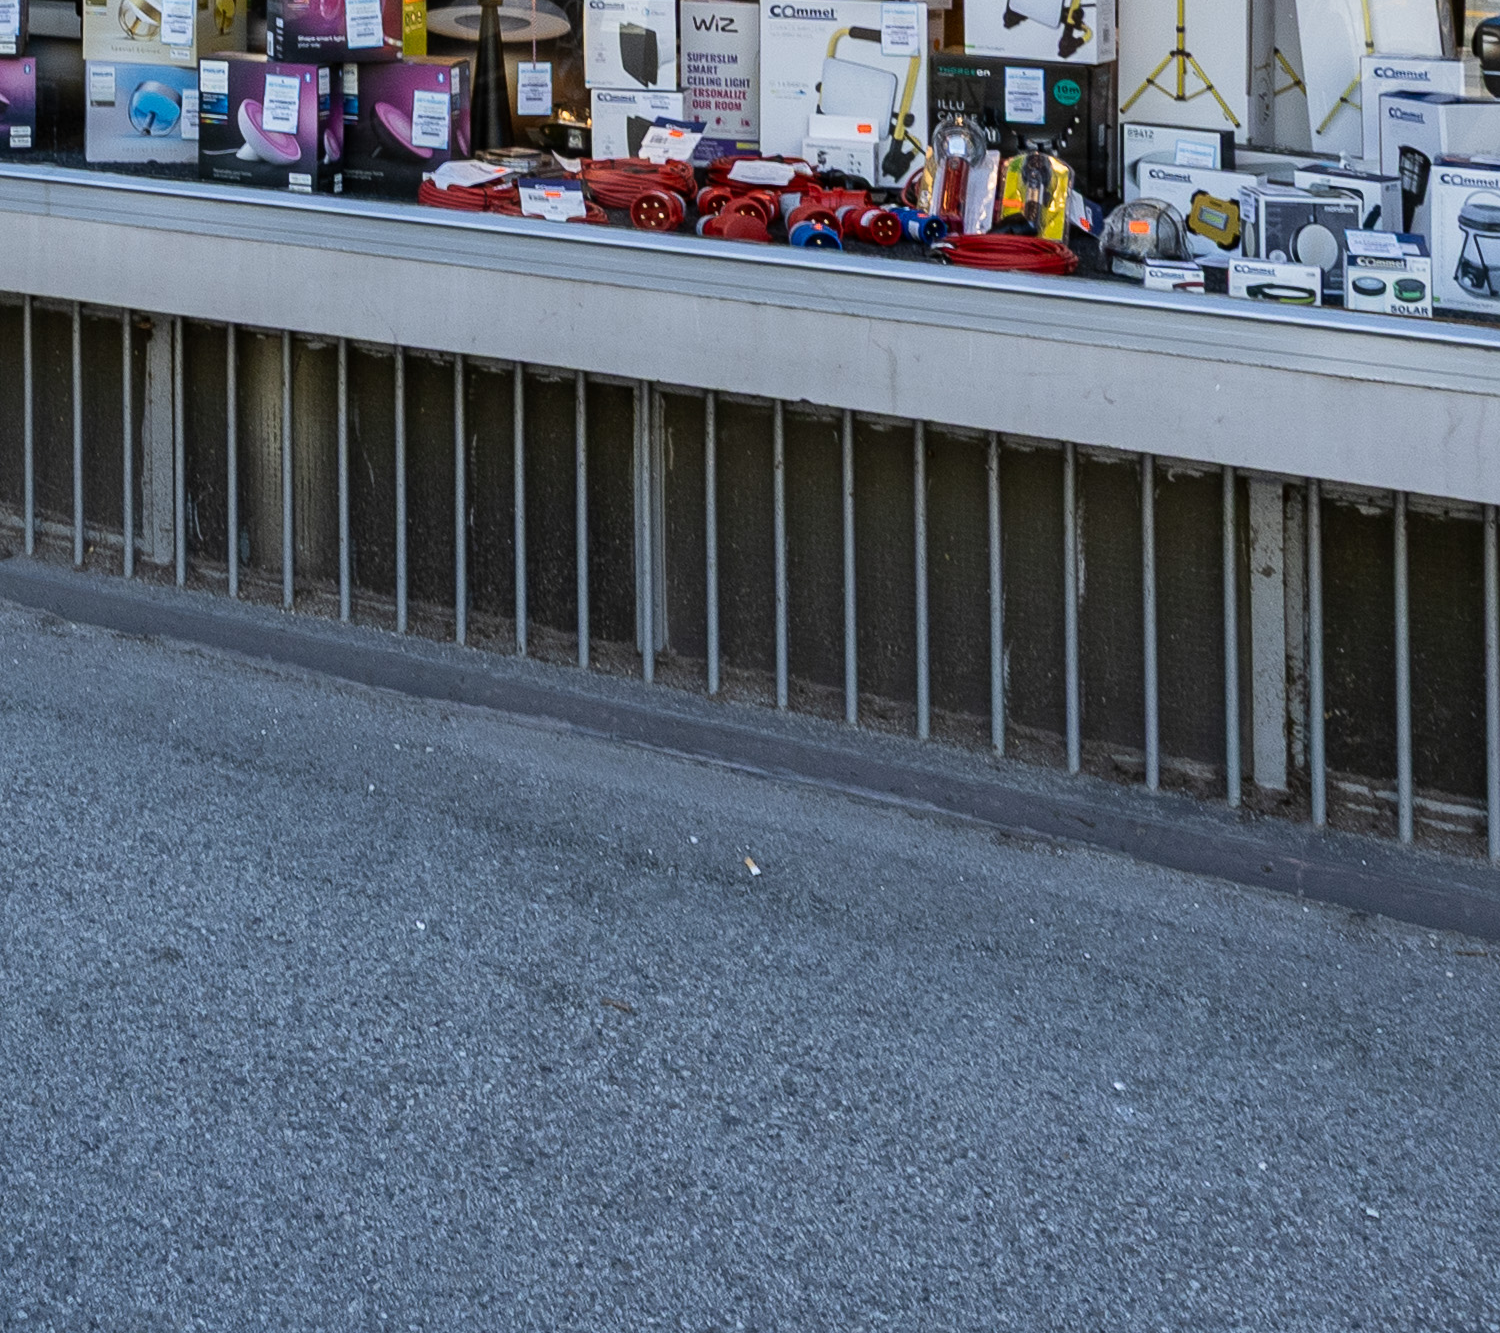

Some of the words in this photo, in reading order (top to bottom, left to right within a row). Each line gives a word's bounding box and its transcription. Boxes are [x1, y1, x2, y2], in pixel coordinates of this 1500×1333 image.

[692, 14, 739, 34] WiZ
[687, 52, 738, 65] SUPERSLIM
[687, 64, 718, 76] SMART
[687, 76, 723, 88] CEILING
[724, 77, 751, 89] LIGHT
[692, 88, 747, 101] ERSONALIZE
[692, 100, 713, 111] OUR
[714, 100, 743, 112] ROOM
[937, 99, 965, 111] ILLU
[1391, 304, 1429, 316] SOLAR
